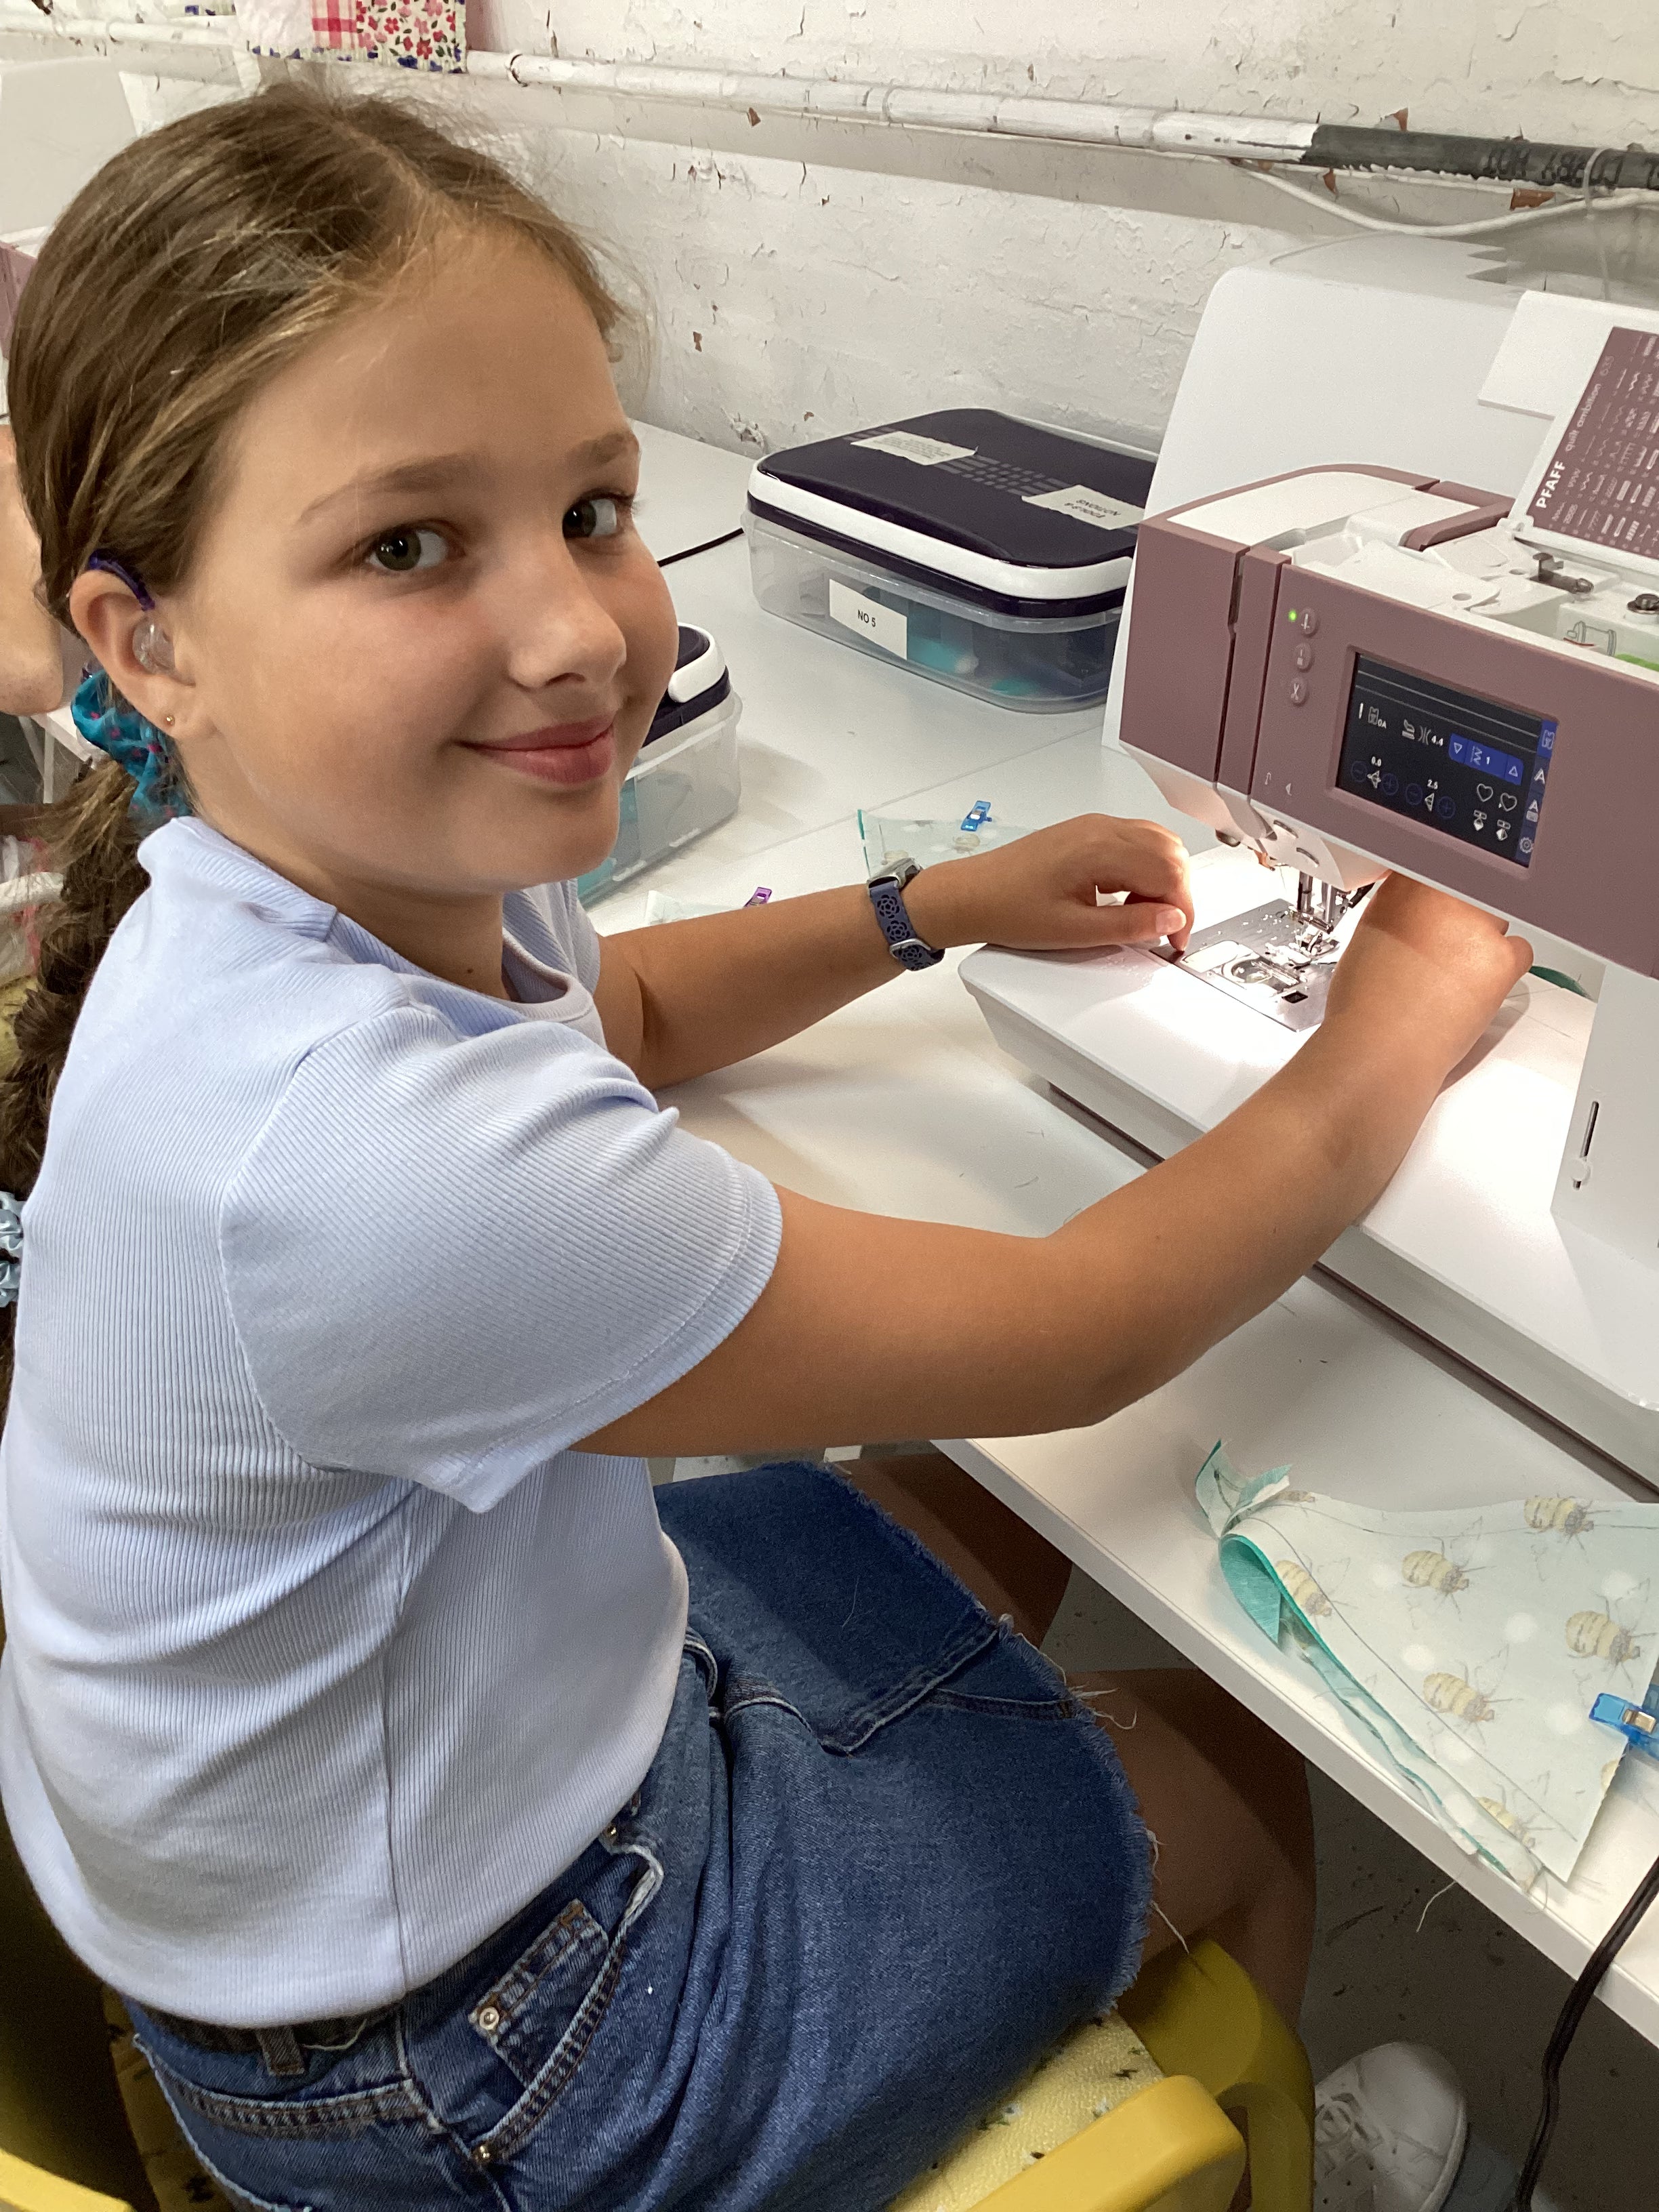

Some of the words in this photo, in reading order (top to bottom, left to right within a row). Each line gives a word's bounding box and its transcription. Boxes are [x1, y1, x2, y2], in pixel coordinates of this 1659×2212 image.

[1535, 461, 1565, 508] PFAFF
[1565, 429, 1580, 452] quilt
[1576, 383, 1602, 428] ambition
[857, 609, 869, 623] NO
[872, 617, 876, 628] 5
[1377, 718, 1387, 729] 0A
[1371, 756, 1382, 767] 0.0
[1486, 756, 1491, 765] 1
